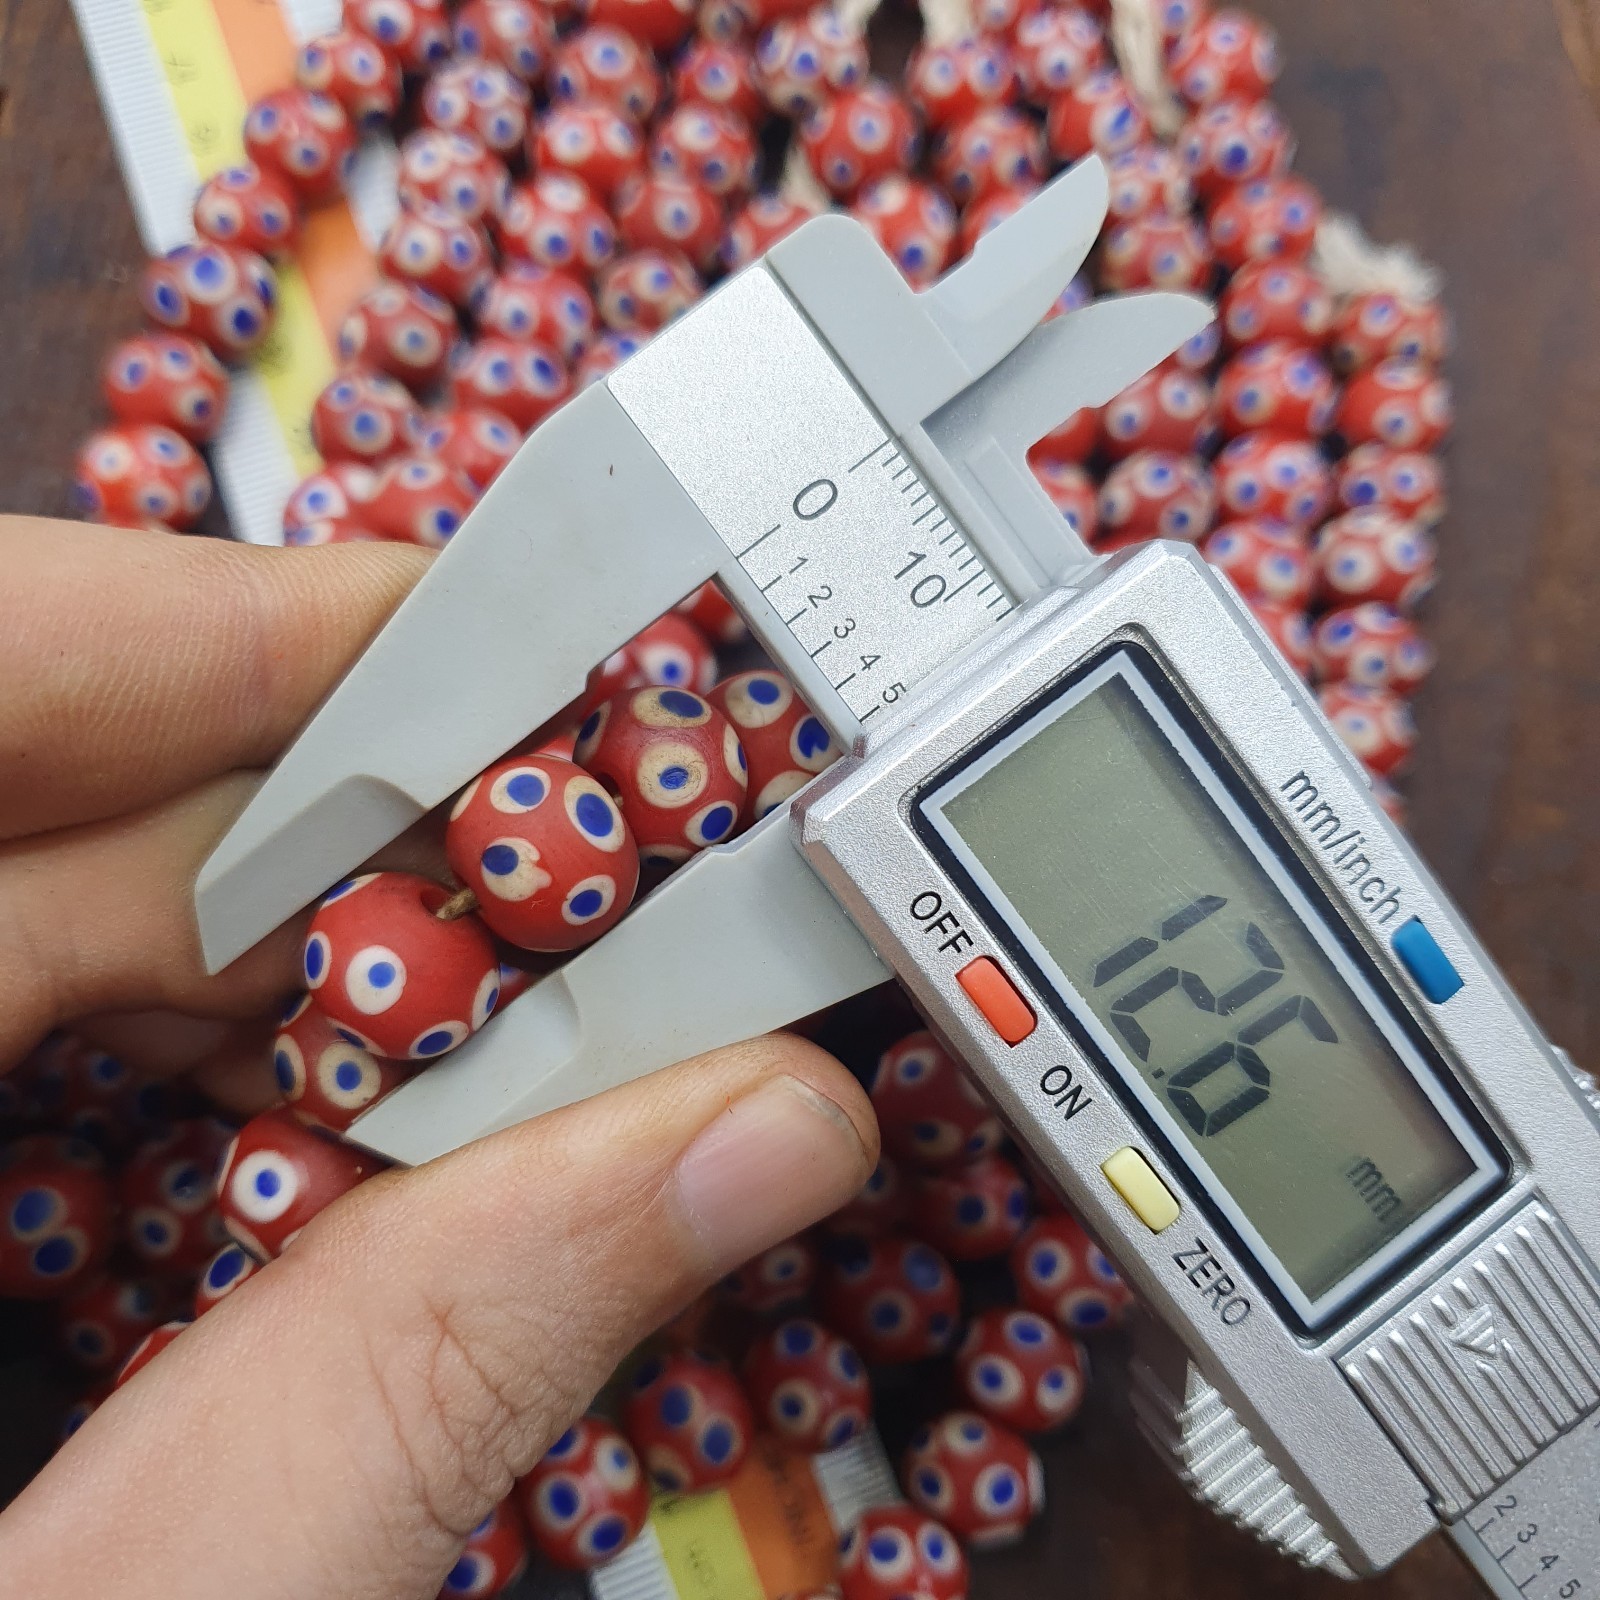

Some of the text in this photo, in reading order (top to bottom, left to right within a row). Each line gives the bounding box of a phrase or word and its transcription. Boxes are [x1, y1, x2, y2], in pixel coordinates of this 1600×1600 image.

[792, 478, 947, 608] 0 10
[789, 556, 907, 704] 1 2 3 4 5
[1279, 769, 1401, 925] mm/inch
[909, 890, 974, 954] OFF
[1039, 1064, 1093, 1121] ON
[1092, 894, 1402, 1222] 12.6 mm
[1171, 1235, 1251, 1326] ZERO
[1493, 1494, 1581, 1599] 2 3 4 5
